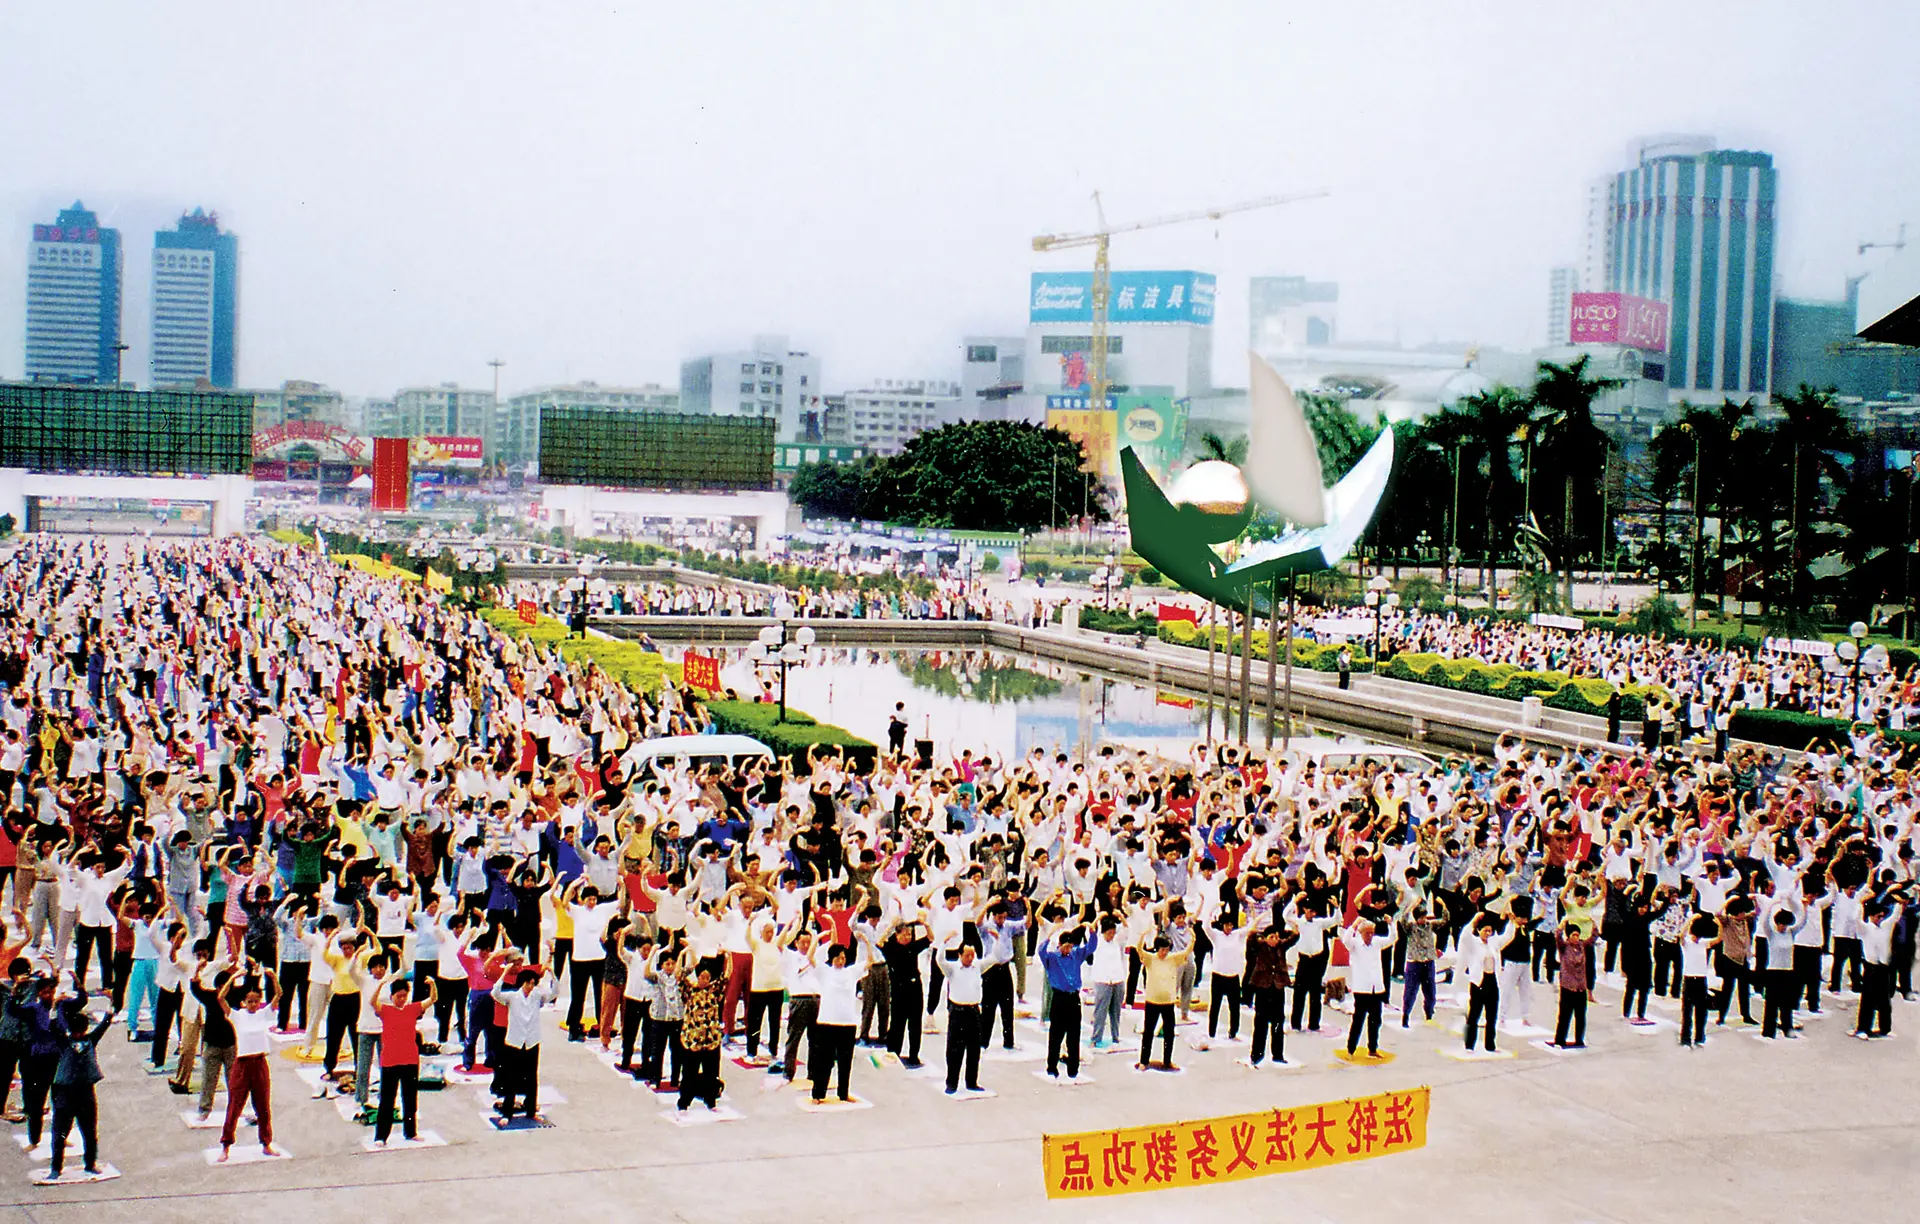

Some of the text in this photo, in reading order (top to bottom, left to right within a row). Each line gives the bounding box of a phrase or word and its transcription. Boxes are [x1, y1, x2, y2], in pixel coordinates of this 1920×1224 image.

[1092, 285, 1185, 309] 标洁具
[1573, 304, 1617, 321] JUSCO
